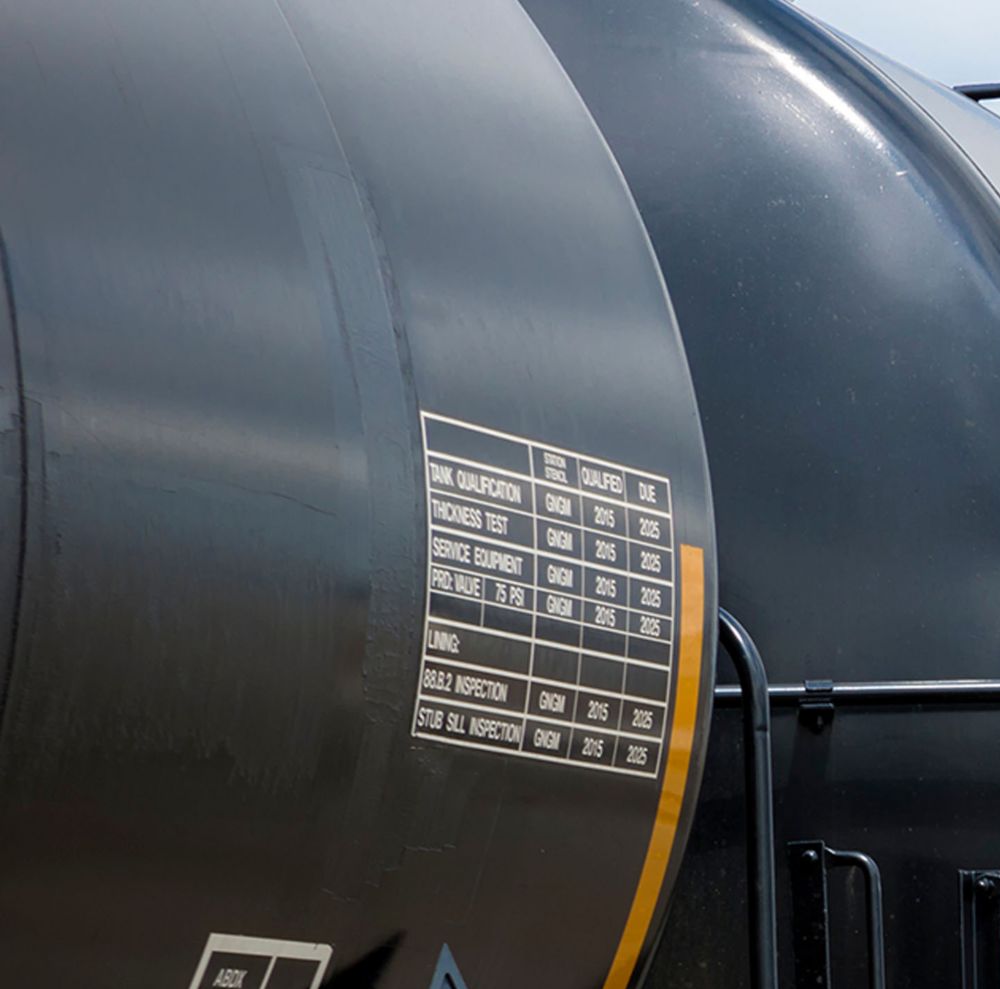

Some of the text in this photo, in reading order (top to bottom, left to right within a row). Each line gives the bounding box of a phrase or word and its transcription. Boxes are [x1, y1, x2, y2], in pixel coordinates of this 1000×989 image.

[430, 462, 454, 487] TANK
[457, 470, 521, 504] QUALIFICATION
[594, 506, 616, 528] 2015
[639, 517, 660, 540] 2025
[581, 466, 656, 503] QUALIFIED DUE
[432, 499, 482, 529] THICKNESS
[485, 511, 508, 535] TEST
[595, 540, 617, 562] 2015
[640, 551, 661, 573] 2025
[433, 537, 471, 563] SERVICE
[474, 547, 523, 576] EQUIPMENT
[595, 576, 617, 598] 2015
[641, 587, 661, 609] 2025
[454, 573, 480, 597] VALVE
[495, 582, 507, 602] 75
[509, 585, 525, 606] PSI
[595, 606, 616, 628] 2015
[640, 615, 661, 637] 2025
[454, 674, 508, 702] INSPECTION
[587, 700, 609, 722] 2015
[632, 708, 653, 730] 2025
[417, 707, 444, 730] STUB
[445, 711, 466, 734] SILL
[469, 716, 522, 743] INSPECTION
[581, 737, 604, 758] 2015
[626, 745, 648, 766] 2025
